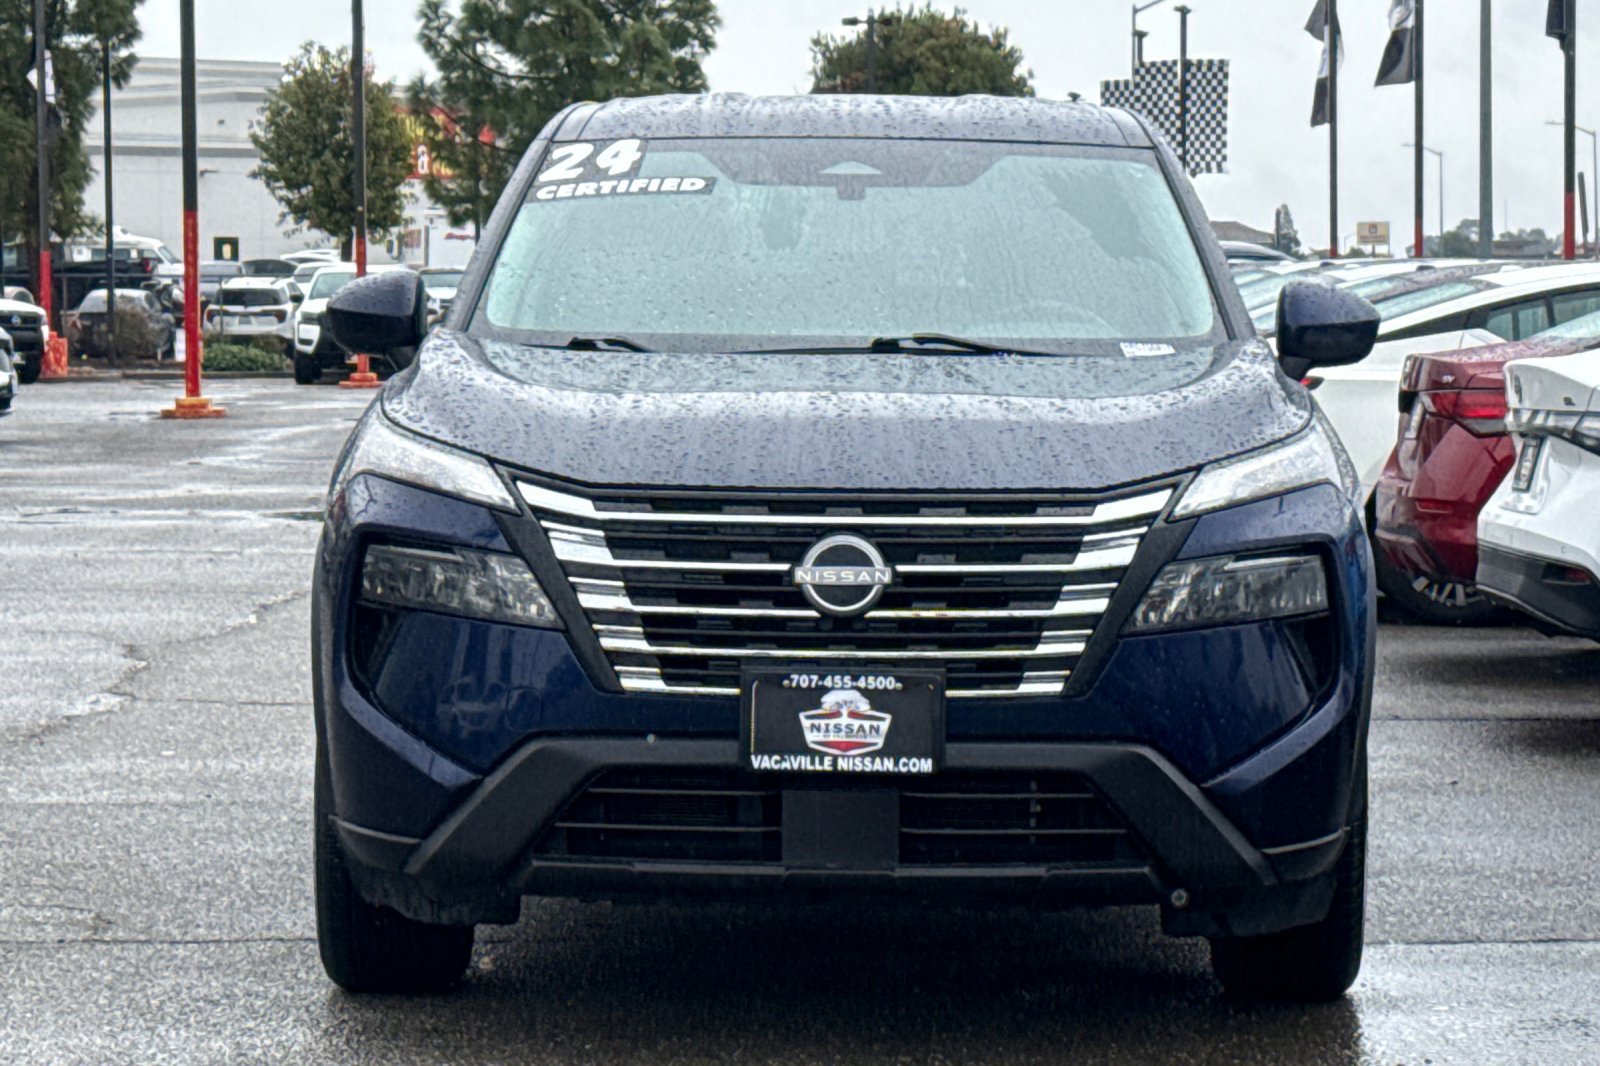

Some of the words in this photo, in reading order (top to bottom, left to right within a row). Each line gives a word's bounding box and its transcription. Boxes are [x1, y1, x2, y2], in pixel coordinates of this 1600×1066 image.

[538, 138, 642, 182] 24
[536, 177, 706, 200] CERTIFIED
[797, 570, 889, 583] NISSAN
[790, 673, 896, 690] 707-455-4500
[810, 722, 880, 735] NISSAN
[751, 754, 833, 771] VACAVILLE
[837, 756, 933, 773] NISSAN.COM
